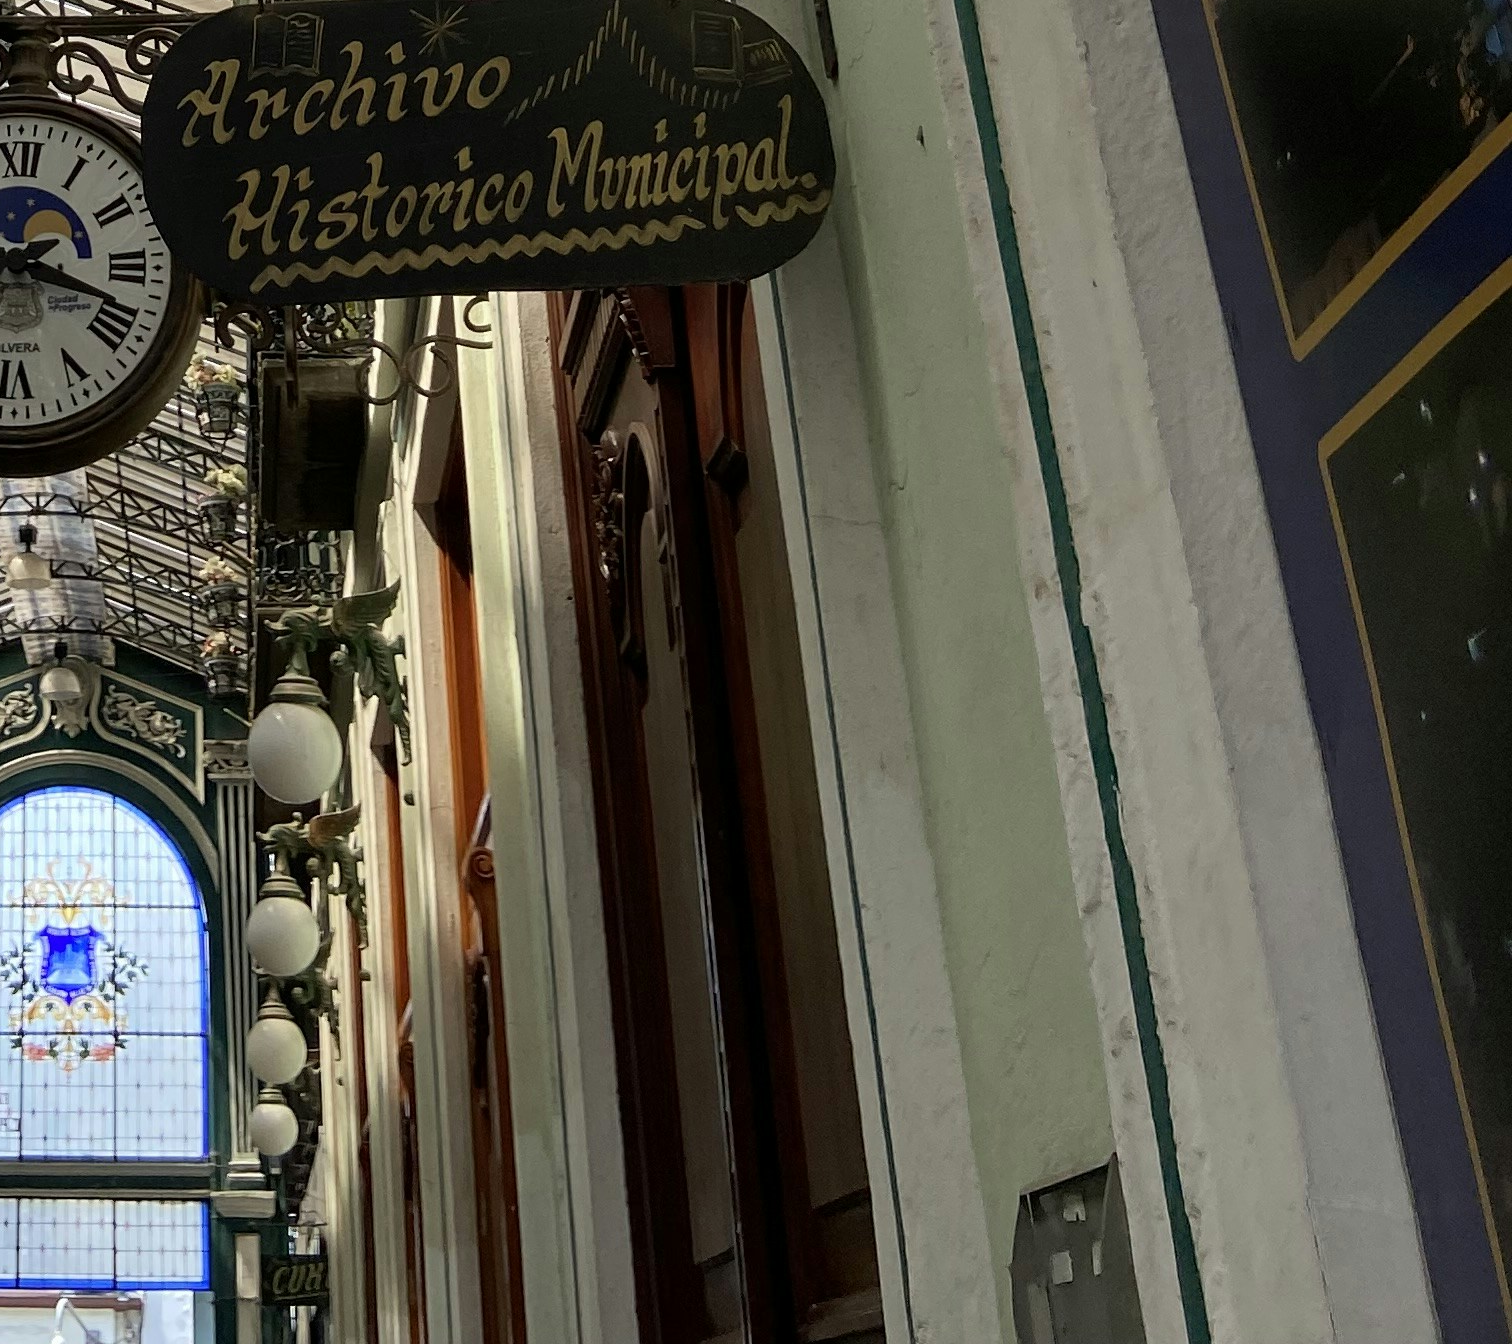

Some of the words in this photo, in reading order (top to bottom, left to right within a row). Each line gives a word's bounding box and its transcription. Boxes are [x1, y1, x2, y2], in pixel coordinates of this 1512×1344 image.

[176, 40, 511, 148] Archivo
[61, 154, 90, 191] I
[92, 192, 135, 230] II
[222, 145, 535, 261] Historico
[108, 247, 148, 288] III
[60, 346, 91, 389] V
